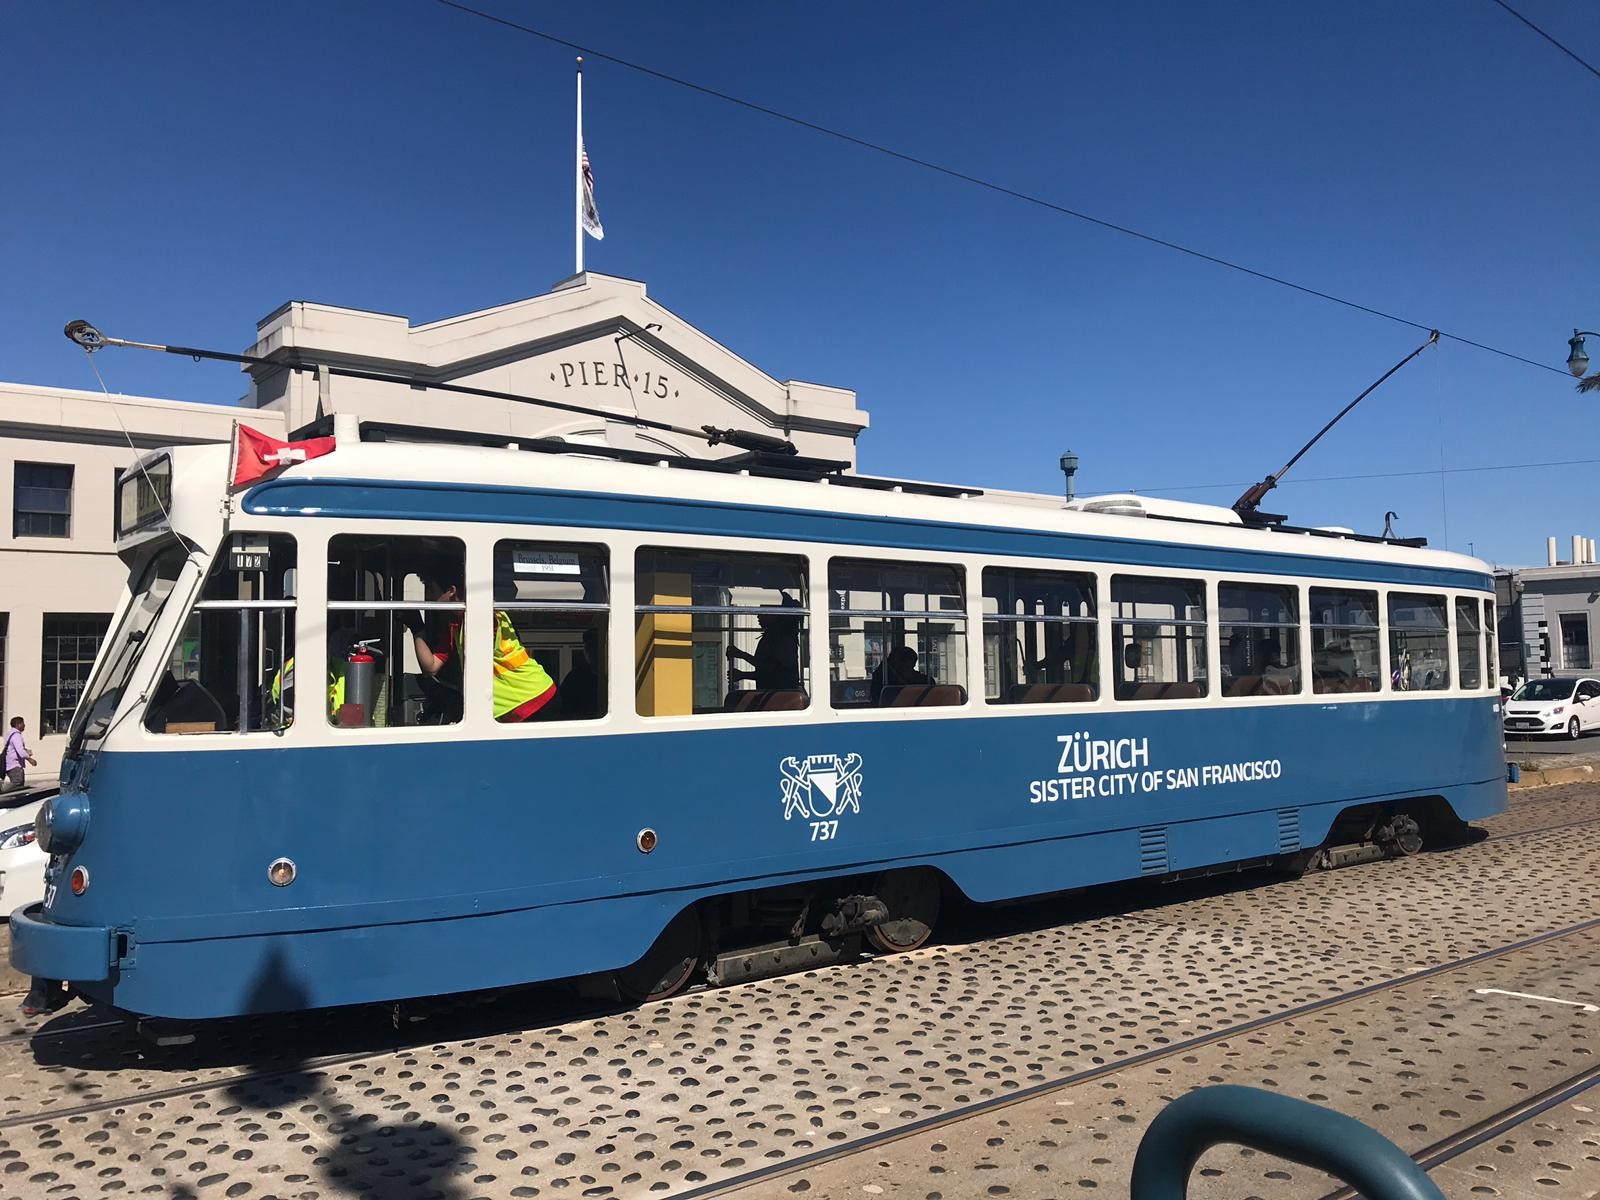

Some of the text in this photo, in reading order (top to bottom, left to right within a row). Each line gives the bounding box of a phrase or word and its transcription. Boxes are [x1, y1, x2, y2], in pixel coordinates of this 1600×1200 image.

[559, 361, 669, 399] PIER 15
[1056, 731, 1149, 774] ZÜRICH
[1029, 759, 1282, 804] SISTER CITY OF SAN FRANCISCO
[808, 819, 839, 843] 737
